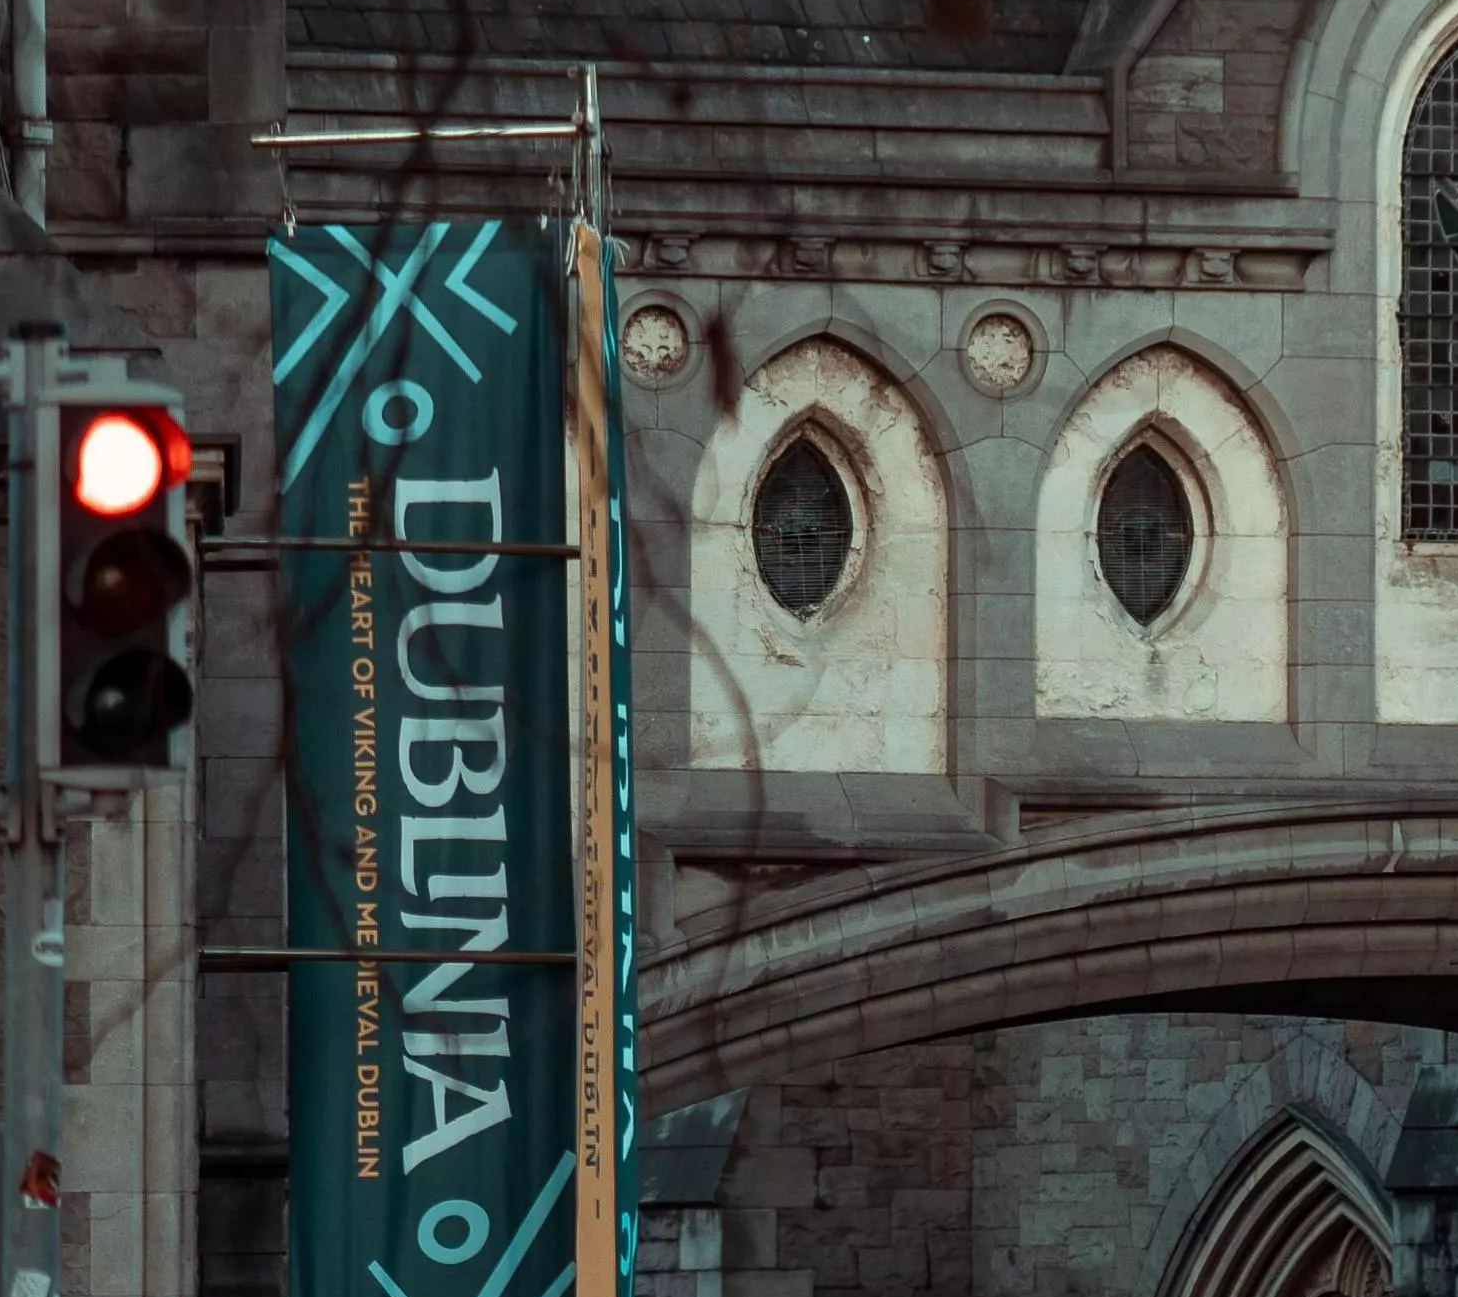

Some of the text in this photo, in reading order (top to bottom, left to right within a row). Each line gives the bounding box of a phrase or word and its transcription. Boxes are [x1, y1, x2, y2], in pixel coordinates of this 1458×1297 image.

[347, 477, 381, 1180] THE HEART OF VIKING AND MEDIEVAL DUBLIN
[394, 467, 512, 1175] DUBLINIA
